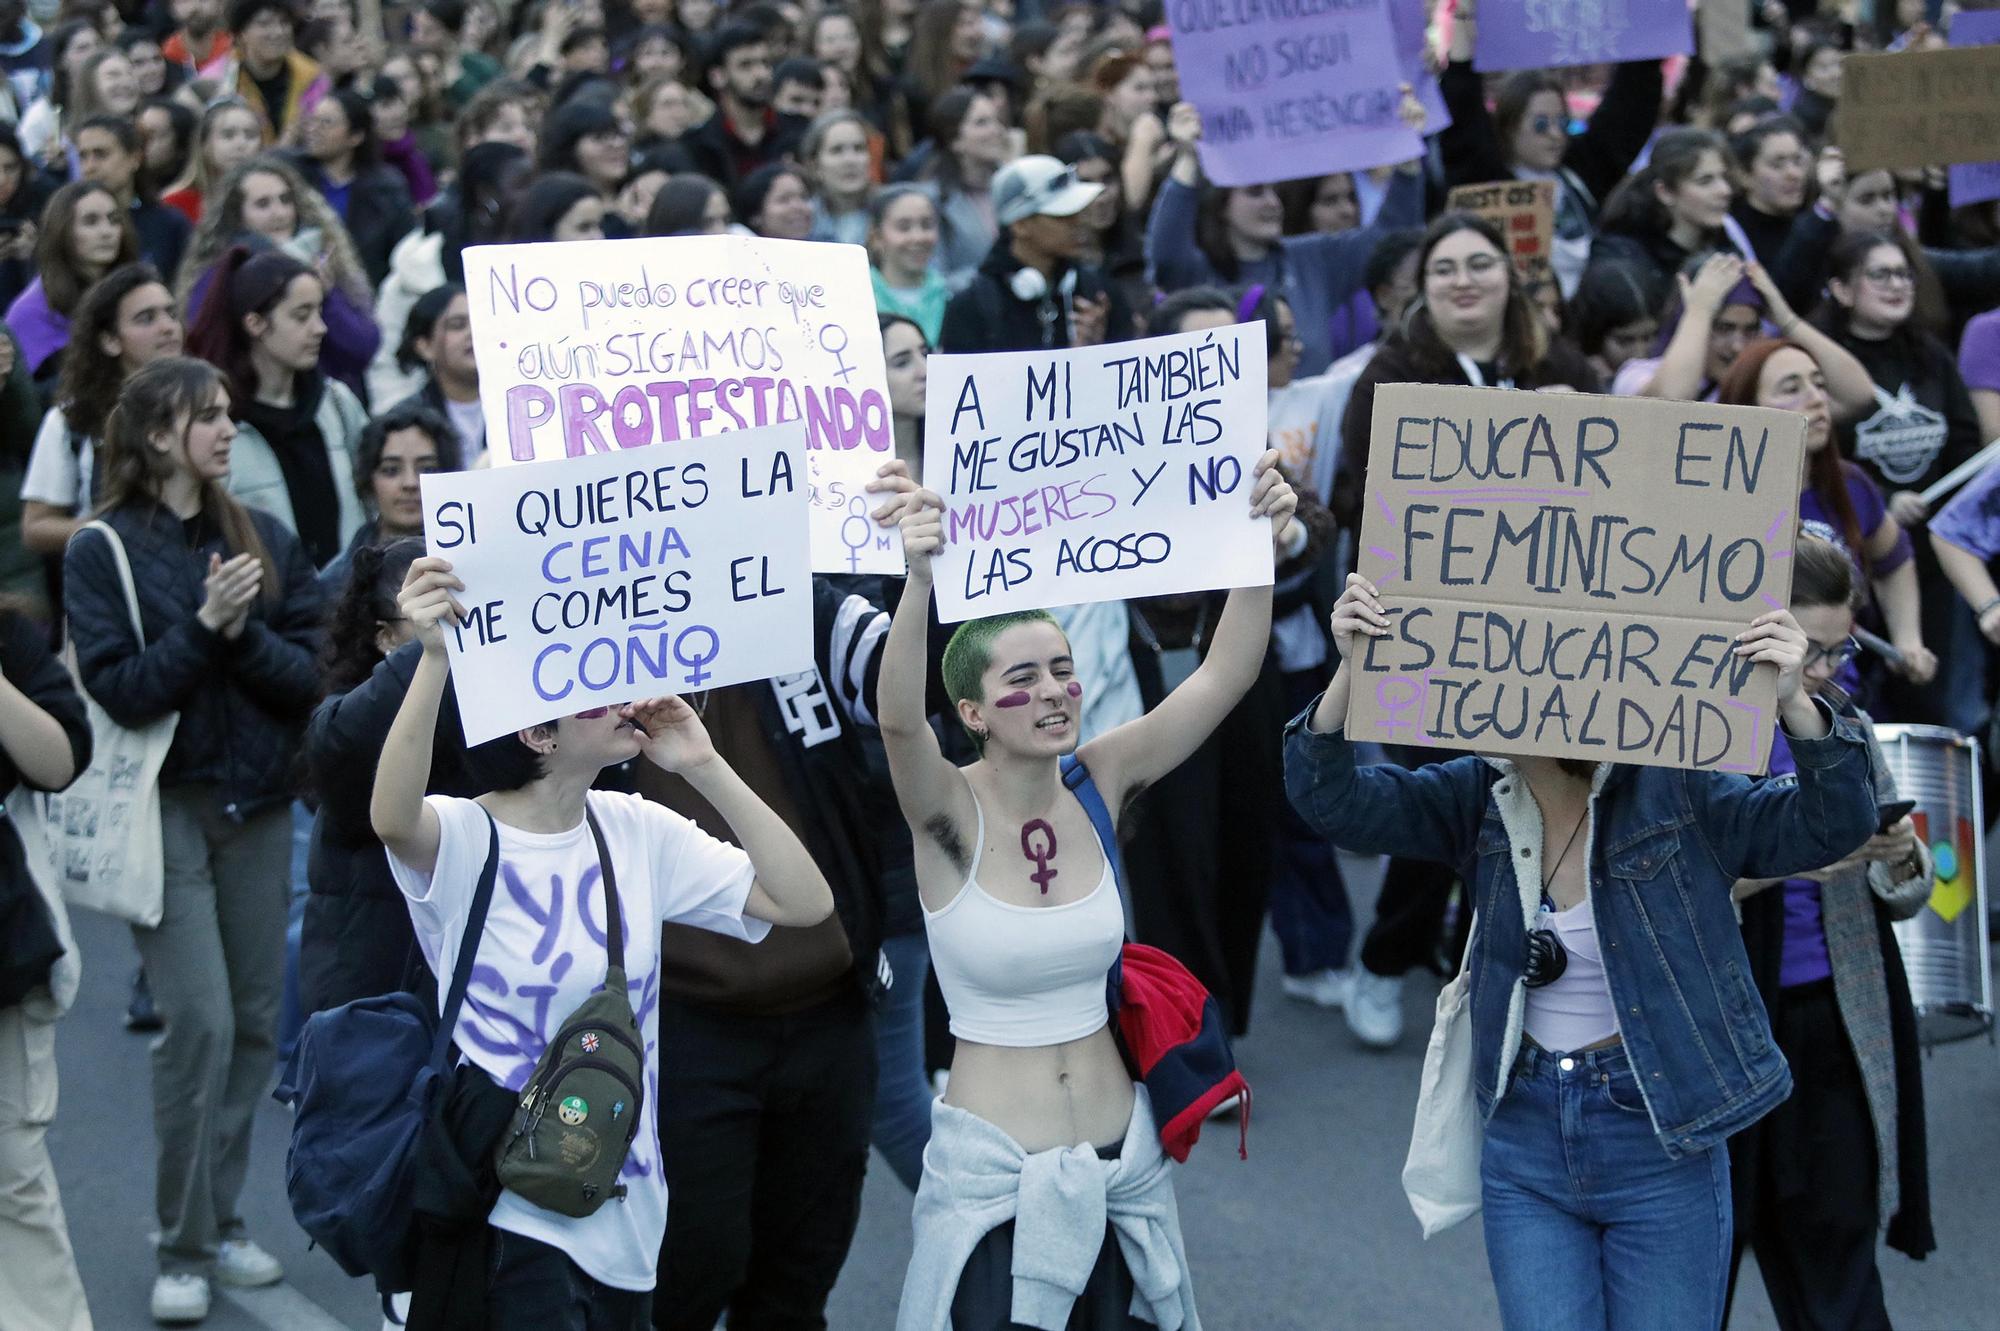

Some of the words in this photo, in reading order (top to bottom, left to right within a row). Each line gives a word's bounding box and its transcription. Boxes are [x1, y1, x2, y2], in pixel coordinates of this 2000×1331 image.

[579, 265, 677, 330] puedo
[686, 277, 769, 308] creer
[778, 282, 826, 324] que
[518, 336, 599, 380] aún
[605, 327, 784, 377] SIGAMOS
[951, 375, 985, 435] A
[1026, 361, 1072, 422] MI
[1103, 332, 1240, 410] TAMBIÉN
[951, 437, 1002, 495] ME
[1008, 412, 1145, 473] GUSTAN
[1162, 399, 1223, 446] LAS
[1391, 413, 1620, 489] EDUCAR
[1674, 423, 1769, 494] EN
[436, 501, 477, 549] SI
[515, 462, 709, 537] QUIERES
[741, 450, 794, 499] LA
[950, 473, 1117, 545] MUJERES
[1132, 461, 1167, 507] Y
[1188, 455, 1242, 506] NO
[541, 526, 692, 585] CENA
[965, 548, 1033, 600] LAS
[1056, 532, 1172, 577] ACOSO
[1403, 503, 1766, 604] FEMINISMO
[455, 600, 508, 653] ME
[531, 570, 692, 635] COMES
[730, 556, 786, 602] EL
[1363, 607, 1436, 673] ES
[1448, 611, 1662, 687] EDUCAR
[1670, 633, 1756, 697] EN
[1426, 678, 1733, 768] IGUALDAD
